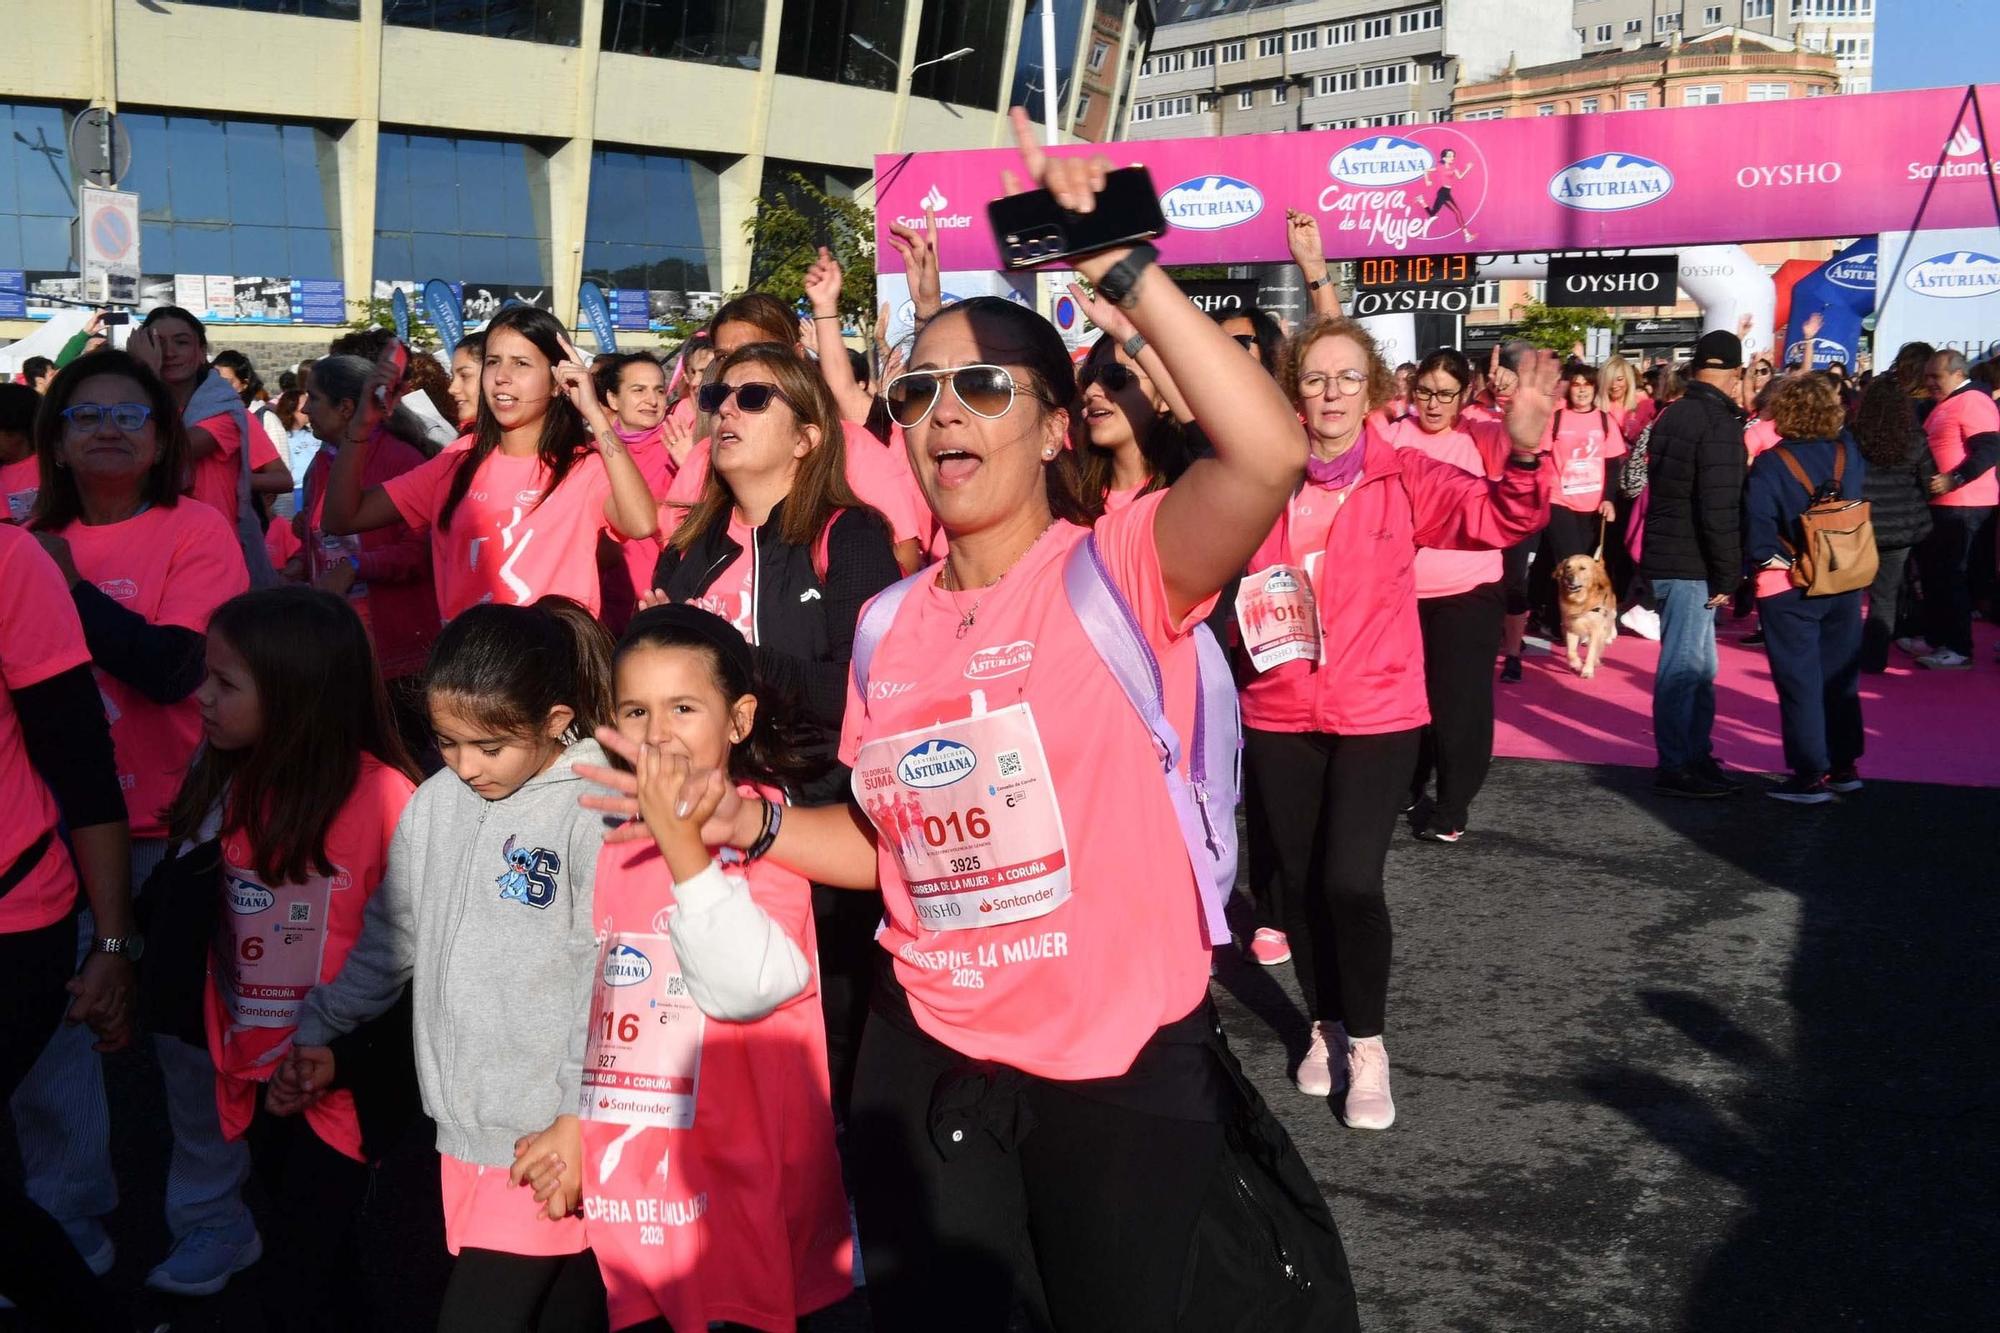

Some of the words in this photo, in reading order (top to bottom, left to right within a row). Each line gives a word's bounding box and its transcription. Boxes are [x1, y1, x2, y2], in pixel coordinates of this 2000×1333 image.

[1337, 156, 1426, 175] ASTURIANA
[1736, 162, 1841, 188] OYSHO
[1558, 177, 1662, 198] ASTURIANA
[1165, 199, 1254, 218] ASTURIANA
[1318, 185, 1408, 212] Carrera
[1339, 214, 1356, 230] de
[1359, 210, 1371, 230] la
[1367, 206, 1439, 250] Mujer
[1362, 255, 1466, 285] 00:10:13
[1681, 264, 1734, 277] OYSHO
[1912, 269, 2000, 288] ASTURIAN
[1566, 272, 1660, 292] OYSHO
[1358, 290, 1468, 314] OYSHO
[870, 767, 892, 777] DORSAL
[904, 756, 972, 781] ASTURIANA
[864, 774, 896, 790] SUMA
[923, 807, 991, 847] 016
[950, 856, 981, 873] 3925
[950, 879, 961, 891] LA
[962, 876, 989, 889] MUJER
[998, 873, 1004, 882] A
[1006, 862, 1048, 881] CORUÑA
[993, 887, 1054, 911] Santander
[918, 902, 961, 919] OYSHO
[978, 942, 998, 967] LA
[952, 968, 984, 988] 2025
[260, 986, 296, 998] CORUÑA
[240, 1005, 295, 1018] Santander
[624, 1076, 630, 1086] A
[634, 1076, 672, 1090] CORUÑA
[611, 1098, 672, 1114] Santander
[636, 1198, 657, 1223] DE
